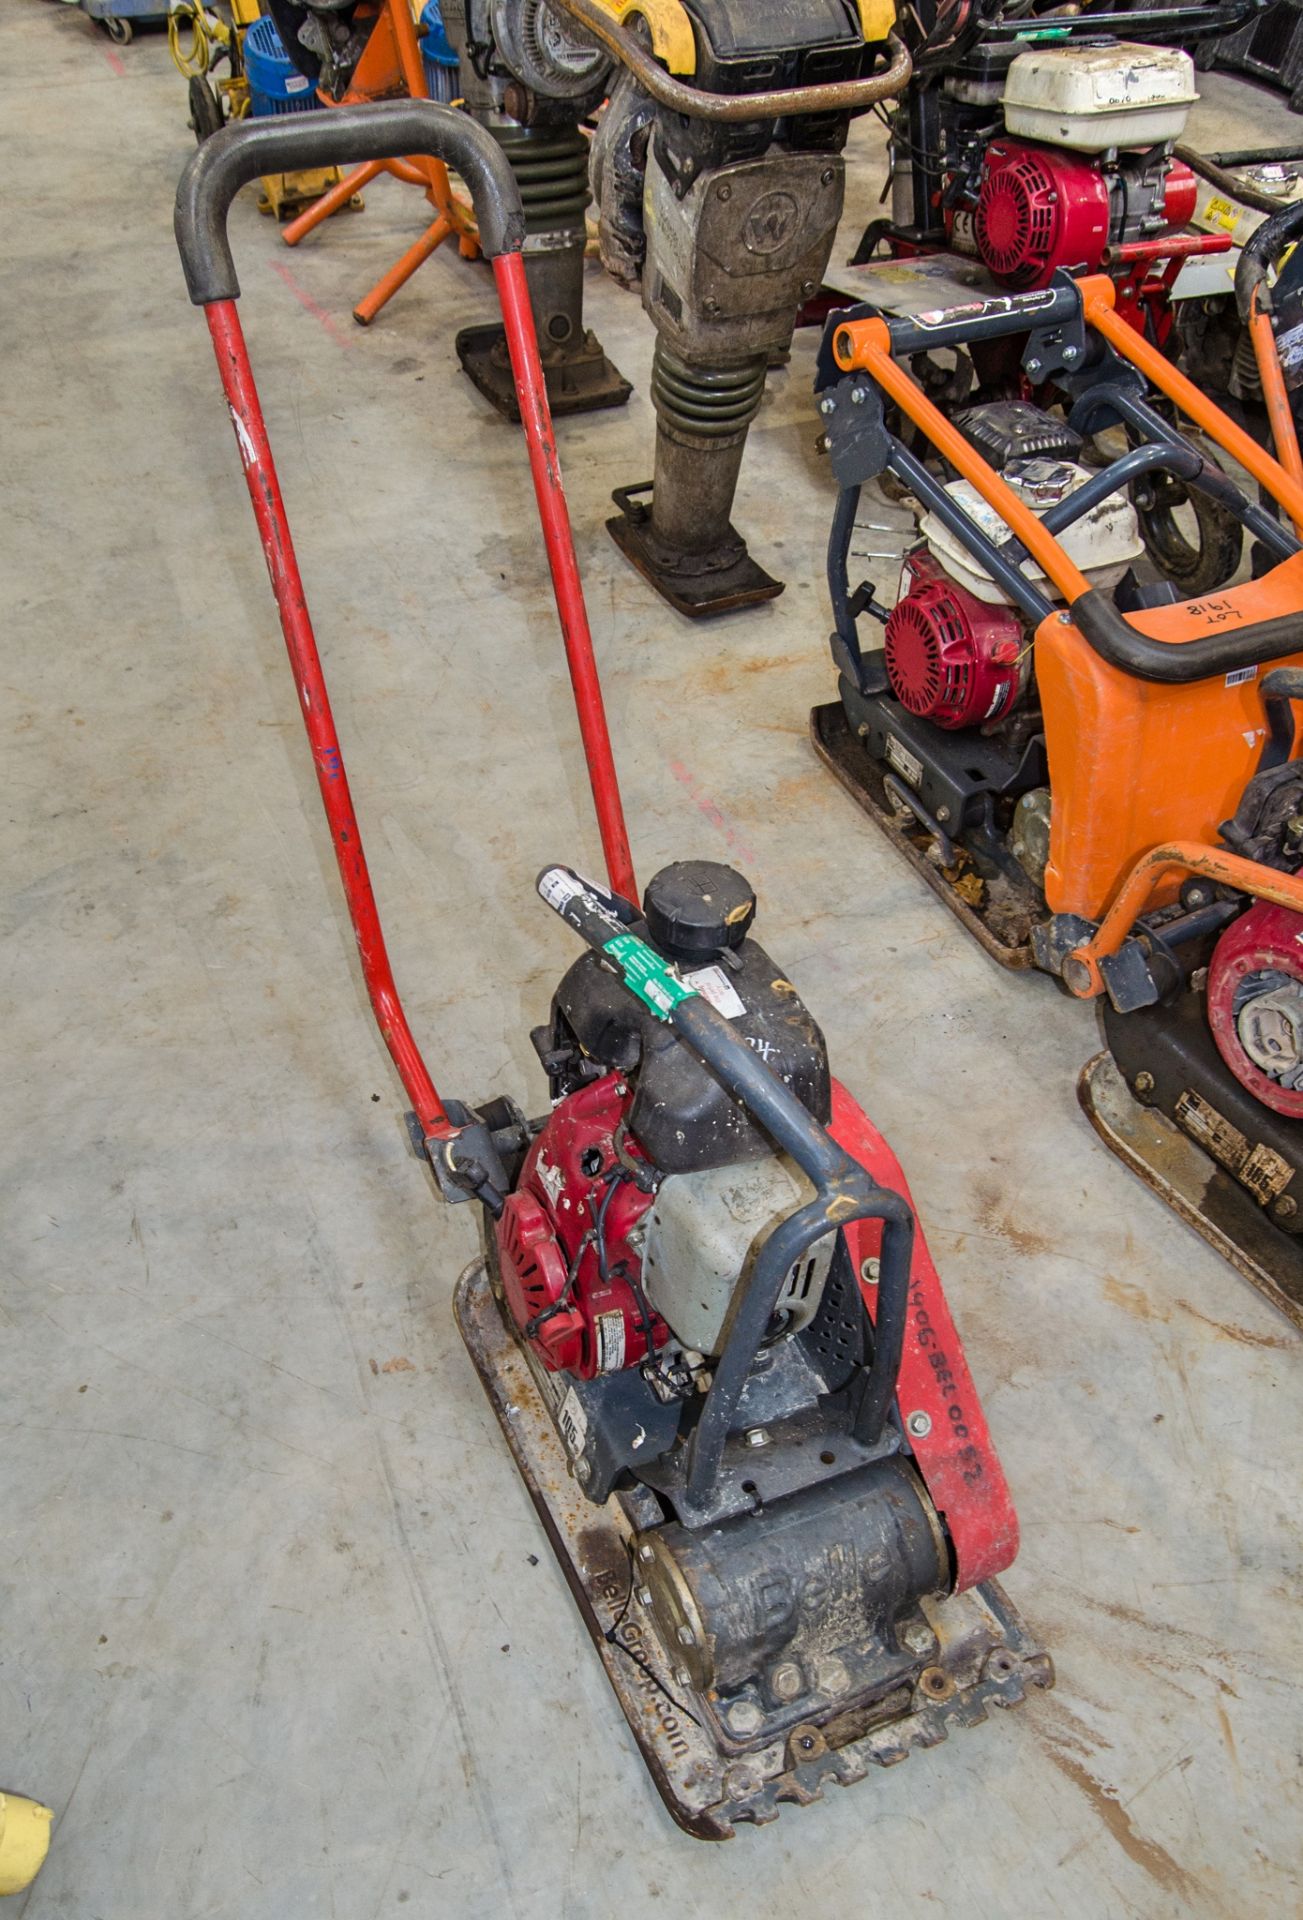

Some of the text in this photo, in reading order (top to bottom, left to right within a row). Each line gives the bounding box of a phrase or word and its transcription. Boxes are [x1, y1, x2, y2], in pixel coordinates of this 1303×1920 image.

[1186, 600, 1233, 616] 1918
[1206, 610, 1243, 625] LOT
[752, 1538, 894, 1634] Belle
